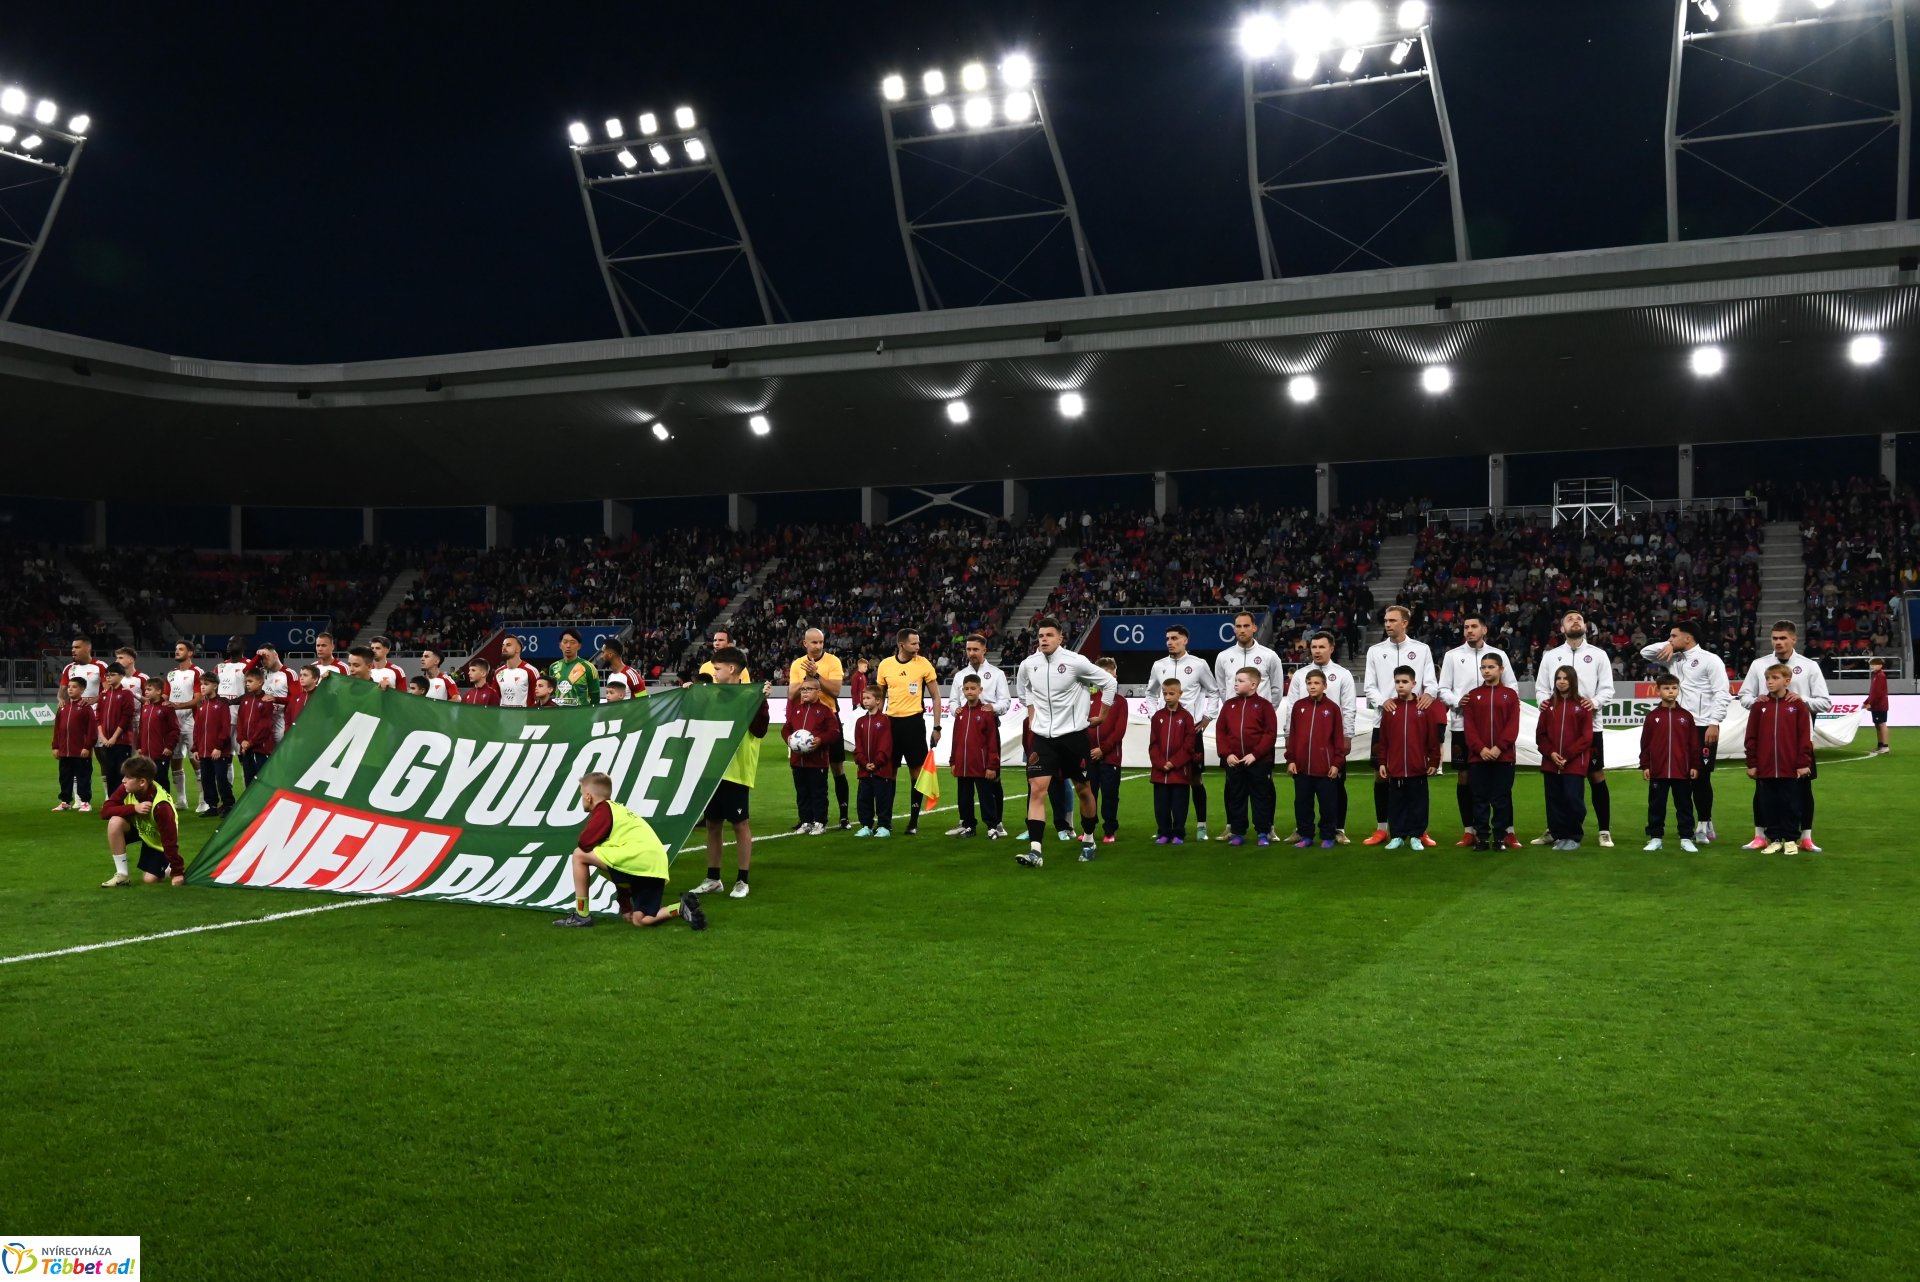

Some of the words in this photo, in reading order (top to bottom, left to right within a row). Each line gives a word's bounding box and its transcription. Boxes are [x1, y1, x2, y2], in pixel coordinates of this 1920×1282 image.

[287, 628, 316, 645] C8
[1113, 624, 1145, 645] C6
[1218, 622, 1236, 643] C
[34, 710, 52, 718] LIGA
[294, 711, 381, 799] A
[368, 719, 735, 827] GYŰLÖLET
[213, 797, 451, 894] NEM
